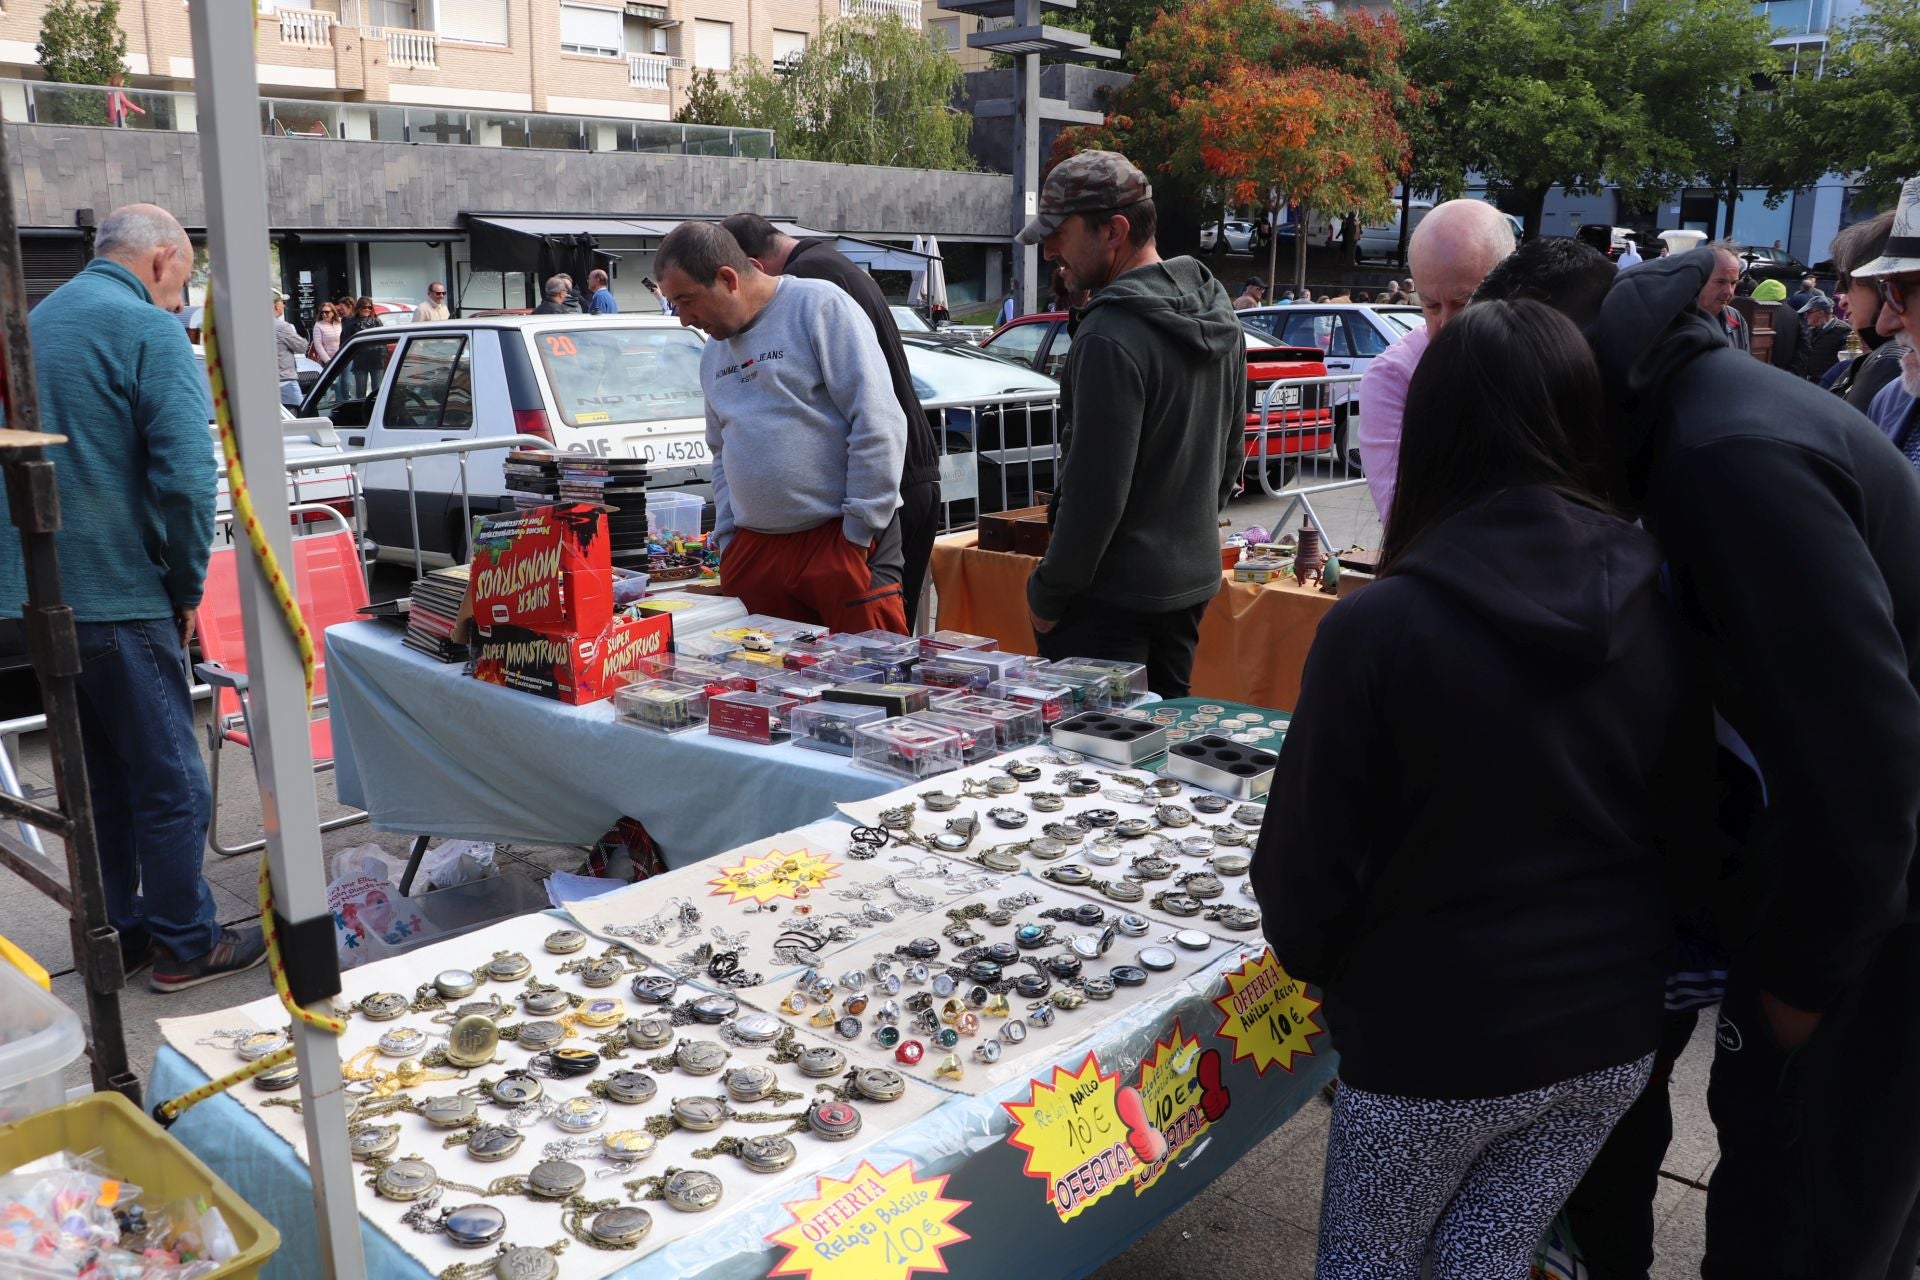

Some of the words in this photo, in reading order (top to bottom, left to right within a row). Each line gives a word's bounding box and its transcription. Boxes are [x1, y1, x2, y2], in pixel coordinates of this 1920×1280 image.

[546, 336, 577, 356] 20
[757, 350, 784, 362] JEANS
[567, 438, 612, 458] elf
[476, 536, 562, 602] MONSTRUOS
[517, 581, 550, 614] SUPER
[482, 643, 505, 661] SUPER
[505, 639, 569, 669] MONSTRUOS
[602, 630, 661, 686] MONSTRUOS
[607, 629, 630, 653] SUPER
[1232, 965, 1280, 1015] OFFERTA
[1268, 1007, 1304, 1045] 10€
[1055, 1144, 1132, 1211] OFERTA
[801, 1177, 887, 1242] OFFERTA
[884, 1219, 941, 1265] 10€
